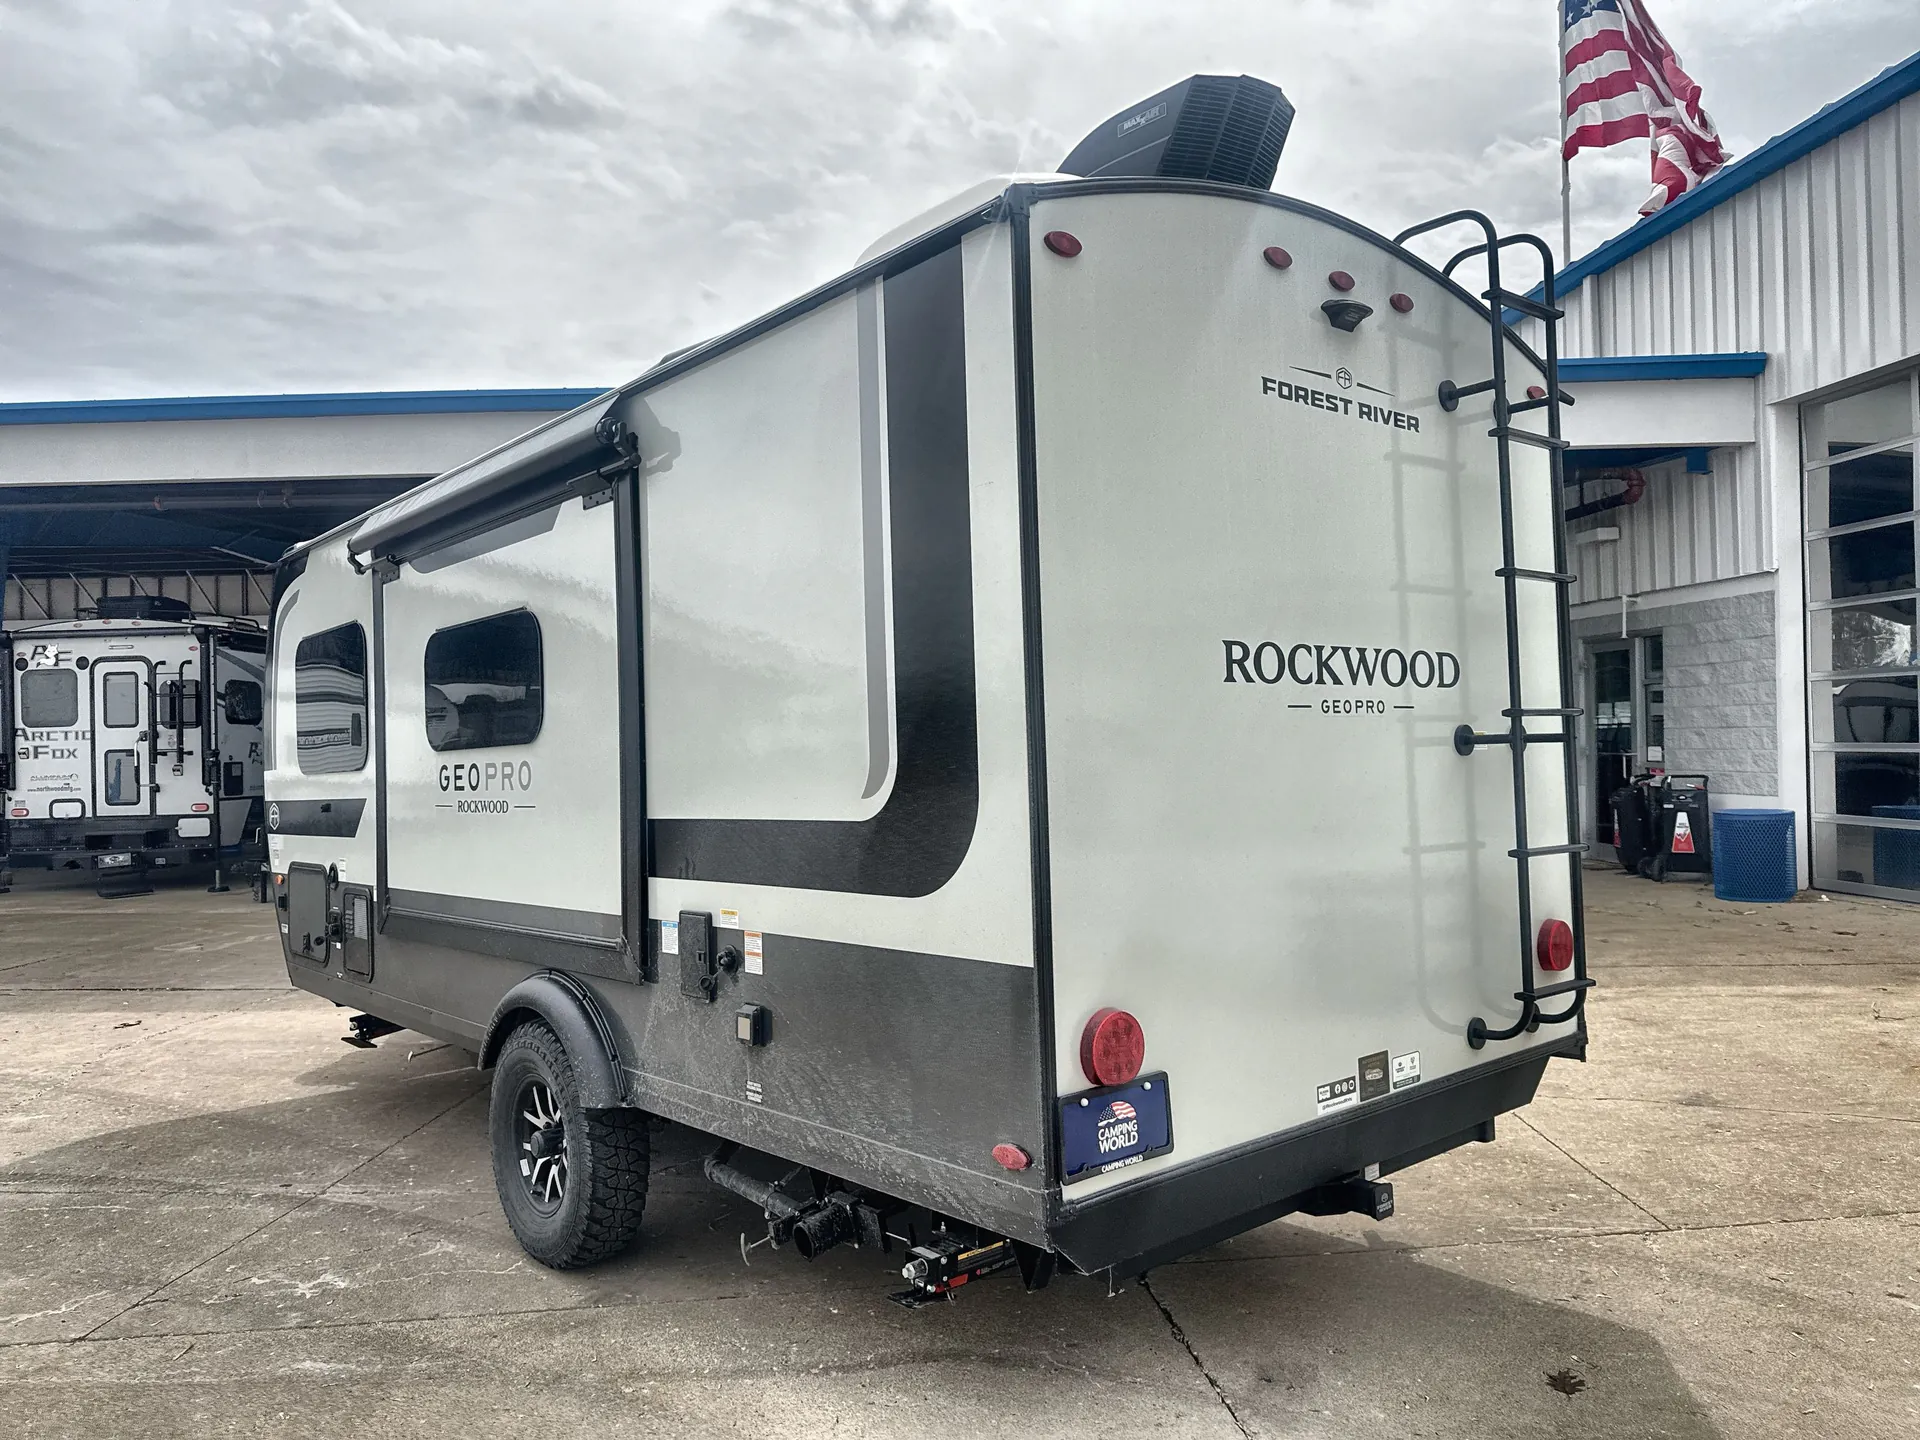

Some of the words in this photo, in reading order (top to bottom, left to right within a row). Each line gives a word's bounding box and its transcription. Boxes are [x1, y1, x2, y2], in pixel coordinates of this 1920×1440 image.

[1261, 375, 1353, 416] FOREST
[1357, 401, 1420, 433] RIVER
[1221, 639, 1461, 689] ROCKWOOD
[1321, 699, 1386, 714] GEOPRO
[15, 728, 91, 741] ARCTIC
[439, 760, 532, 792] GEOPRO
[457, 800, 509, 814] ROCKWOOD
[1098, 1120, 1138, 1141] CAMPING
[1099, 1132, 1138, 1154] WORLD
[1101, 1159, 1125, 1173] CAMPING
[1124, 1154, 1144, 1166] WORLD
